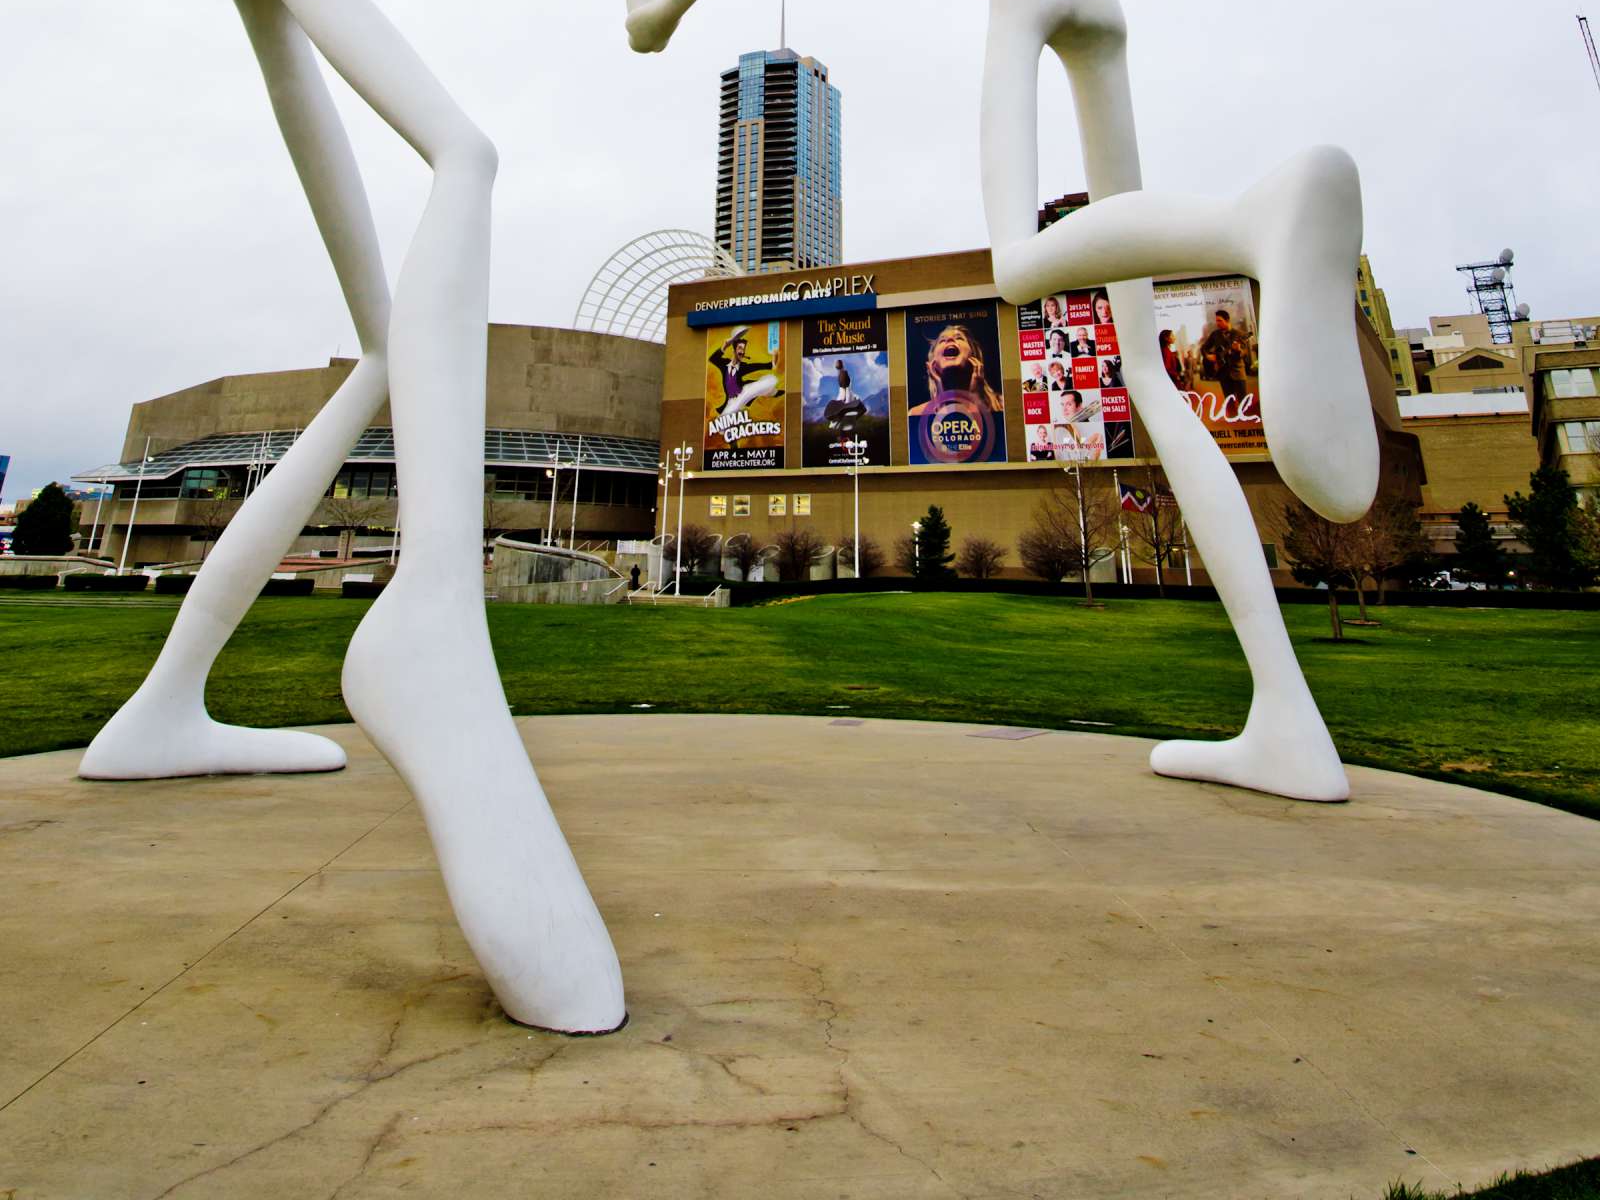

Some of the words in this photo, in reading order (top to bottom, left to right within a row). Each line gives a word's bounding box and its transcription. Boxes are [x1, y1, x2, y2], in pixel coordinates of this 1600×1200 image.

[781, 274, 876, 298] COMPLEX
[695, 299, 729, 312] DENVER
[729, 290, 800, 307] PERFORMING
[803, 286, 832, 300] ARTS
[1069, 311, 1091, 319] SEASON
[818, 319, 836, 333] The
[839, 315, 871, 332] Sound
[823, 332, 834, 345] of
[836, 331, 865, 345] Music
[1022, 341, 1044, 349] MASTER
[1023, 348, 1043, 357] WORKS
[1075, 365, 1095, 373] FAMILY
[1102, 395, 1126, 404] TICKETS
[1027, 408, 1042, 416] ROCK
[1111, 405, 1127, 413] SALE!
[708, 410, 752, 437] ANIMAL
[931, 419, 981, 434] OPERA
[724, 422, 781, 443] CRACKERS
[932, 433, 982, 443] COLORADO
[712, 451, 729, 460] APR
[731, 451, 737, 459] 4
[746, 449, 768, 459] MAY
[769, 449, 776, 458] 11
[711, 458, 776, 468] DENVERCENTER.ORG
